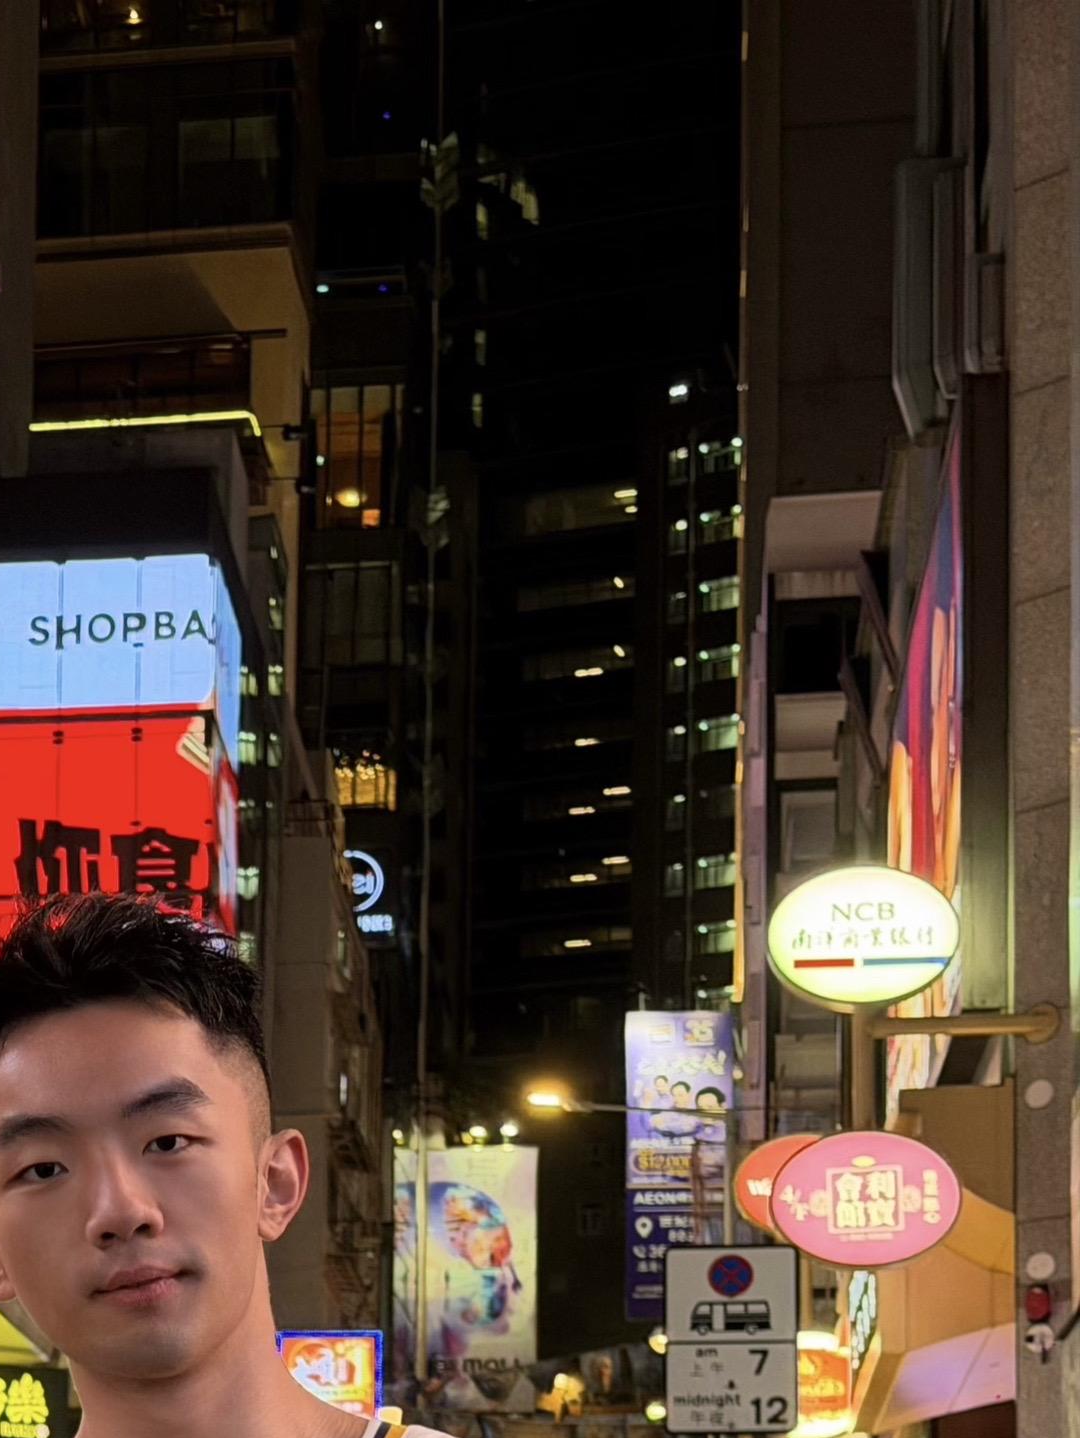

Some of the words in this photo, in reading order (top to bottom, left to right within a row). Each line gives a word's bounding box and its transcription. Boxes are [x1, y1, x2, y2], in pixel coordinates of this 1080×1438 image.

[28, 610, 216, 650] SHOPBA
[831, 902, 896, 922] NCB
[749, 1349, 770, 1376] 7
[673, 1393, 741, 1407] midnight
[751, 1396, 789, 1426] 12
